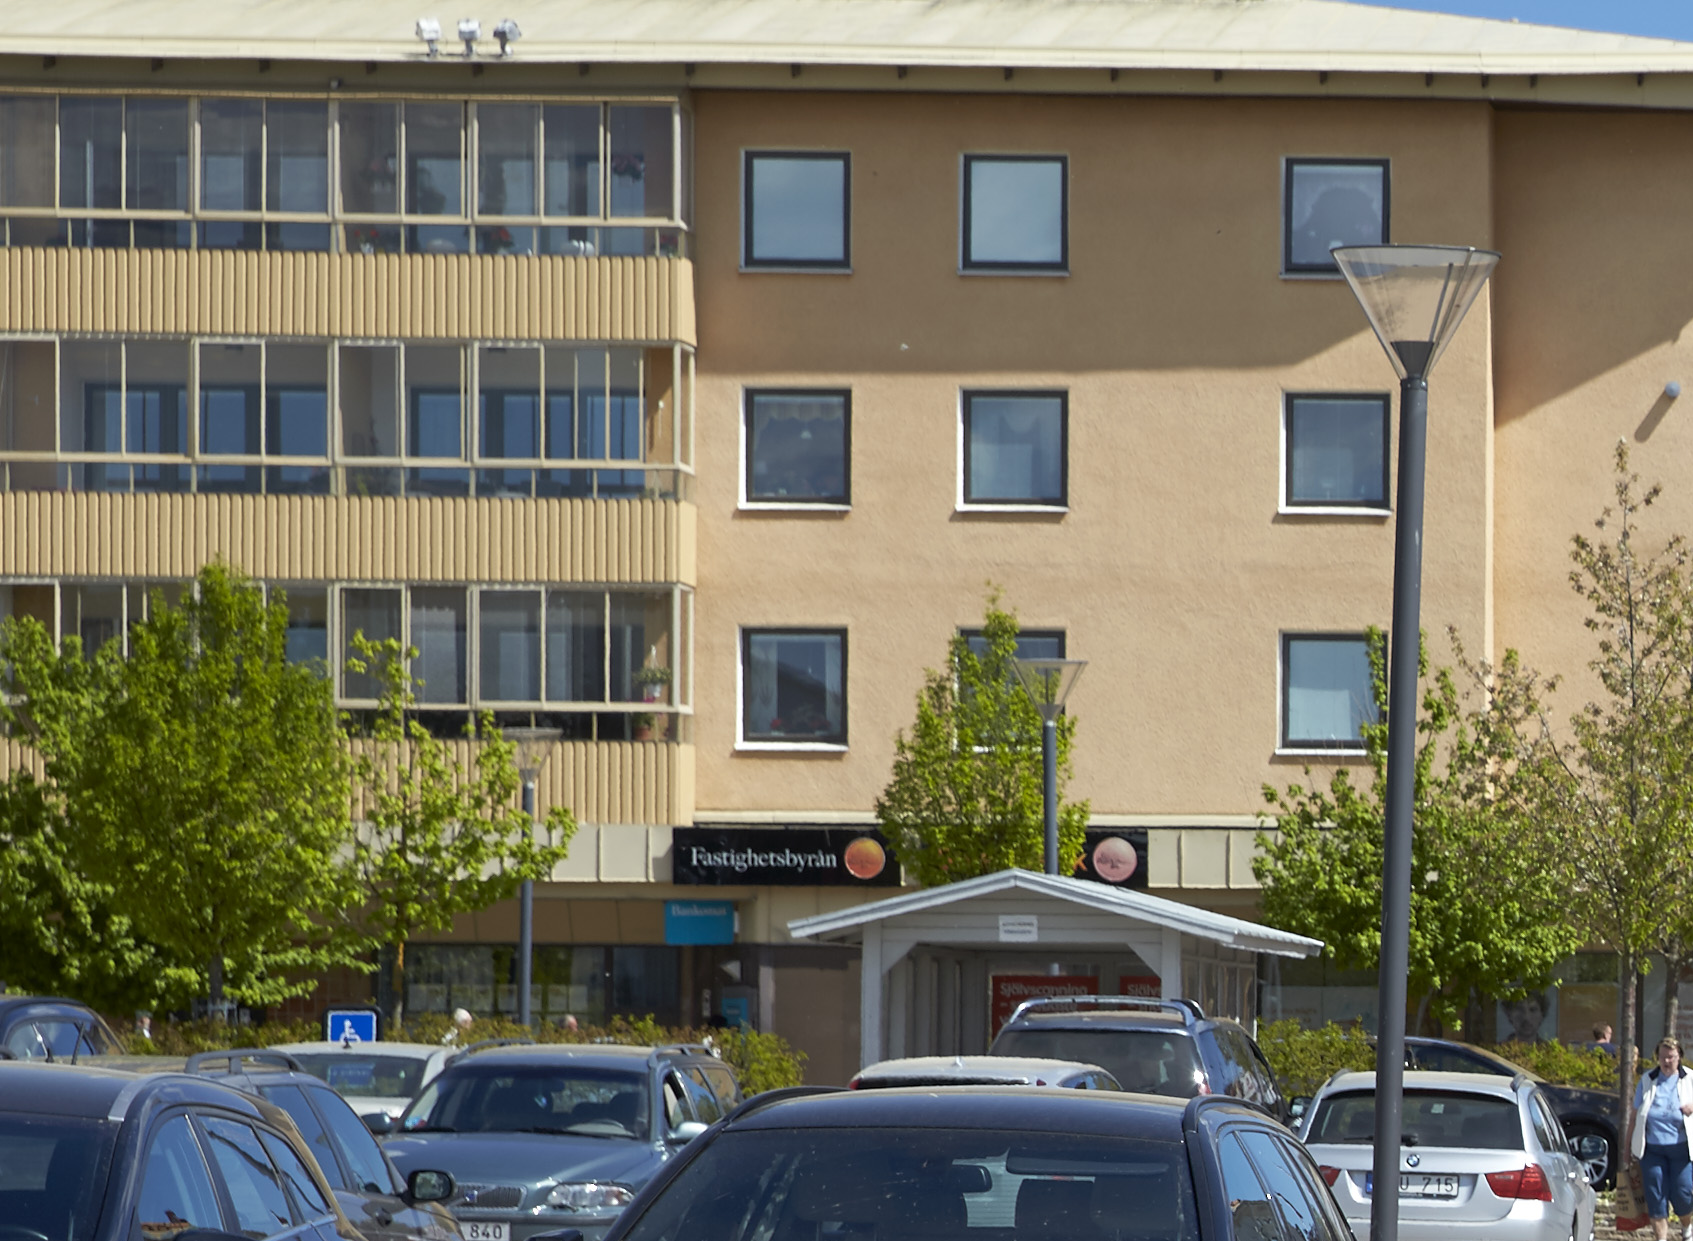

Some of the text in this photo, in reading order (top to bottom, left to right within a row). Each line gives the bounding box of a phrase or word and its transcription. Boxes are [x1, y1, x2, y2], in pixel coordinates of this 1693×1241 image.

[690, 846, 838, 873] Fastighetsbyrån
[671, 903, 727, 917] Bankomat
[1422, 1176, 1454, 1193] 715
[470, 1223, 503, 1240] 840
